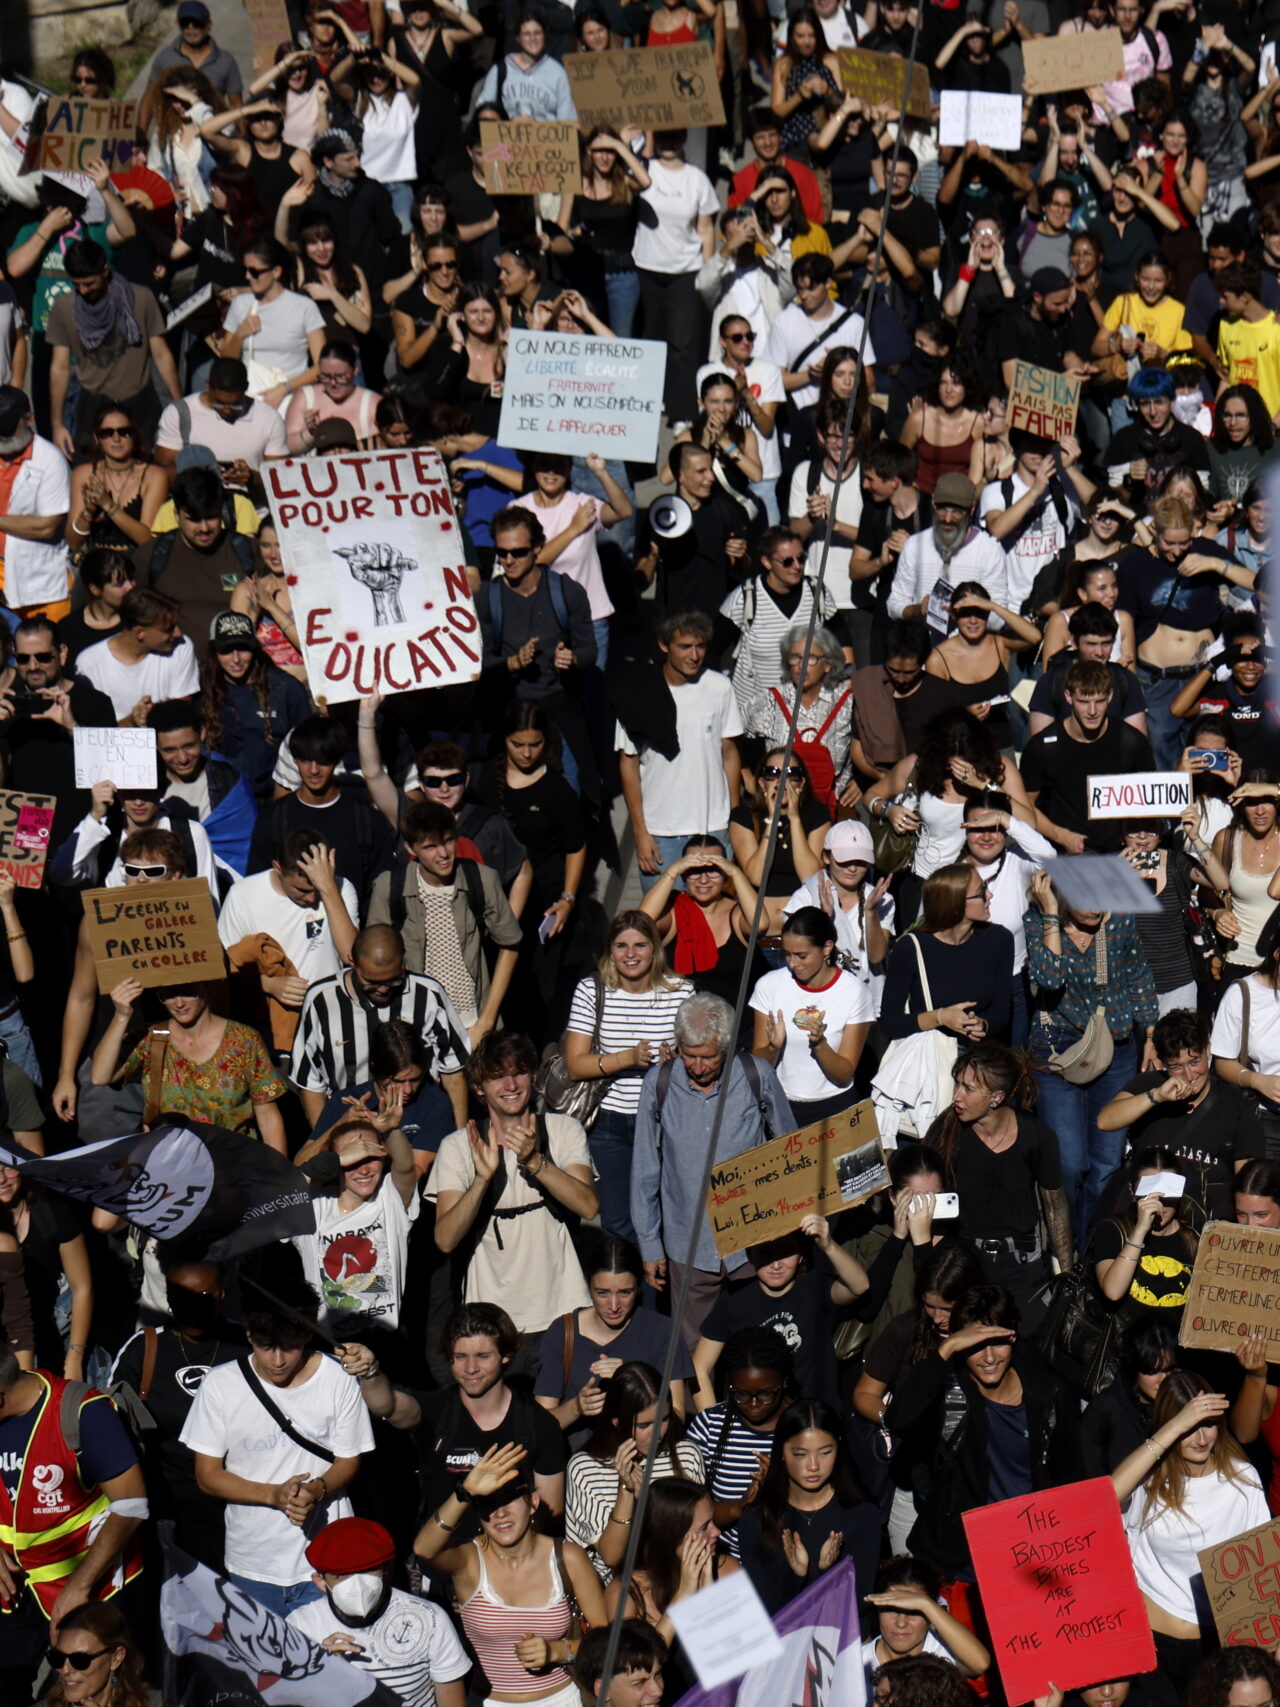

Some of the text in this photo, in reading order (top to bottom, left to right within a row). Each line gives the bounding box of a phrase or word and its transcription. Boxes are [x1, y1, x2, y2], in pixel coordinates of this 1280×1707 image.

[91, 104, 134, 131] THE
[41, 134, 117, 171] RICH
[516, 338, 644, 360] ON NOUS APPREND
[547, 378, 617, 395] FRATERNITÉ
[511, 393, 544, 409] MAIS
[549, 393, 567, 408] ON
[1011, 389, 1073, 420] MAIS PAS
[516, 417, 628, 437] DE L'APPLIQUER
[268, 450, 442, 500] LUTTE
[278, 486, 454, 529] POUR TON
[75, 728, 157, 750] JEUNESSE
[105, 745, 126, 763] EN
[93, 899, 170, 925] LYCÉENS
[144, 913, 197, 930] GALÈRE
[105, 932, 186, 958] PARENTS
[150, 950, 208, 968] COLÈRE
[849, 1109, 863, 1128] et
[784, 1134, 803, 1156] 15
[754, 1169, 780, 1187] mes
[776, 1196, 791, 1217] 14
[1208, 1233, 1265, 1255] OUVRIR
[1198, 1284, 1249, 1305] FERMER
[1248, 1292, 1274, 1310] UNE
[1192, 1315, 1238, 1336] OUVRE
[36, 1488, 65, 1508] cgt
[1016, 1503, 1061, 1533] THE
[1009, 1530, 1097, 1569] BADDEST
[1220, 1536, 1265, 1579] ON
[1044, 1584, 1074, 1604] ARE
[1055, 1599, 1077, 1619] AT
[1005, 1608, 1128, 1654] THE PROTEST
